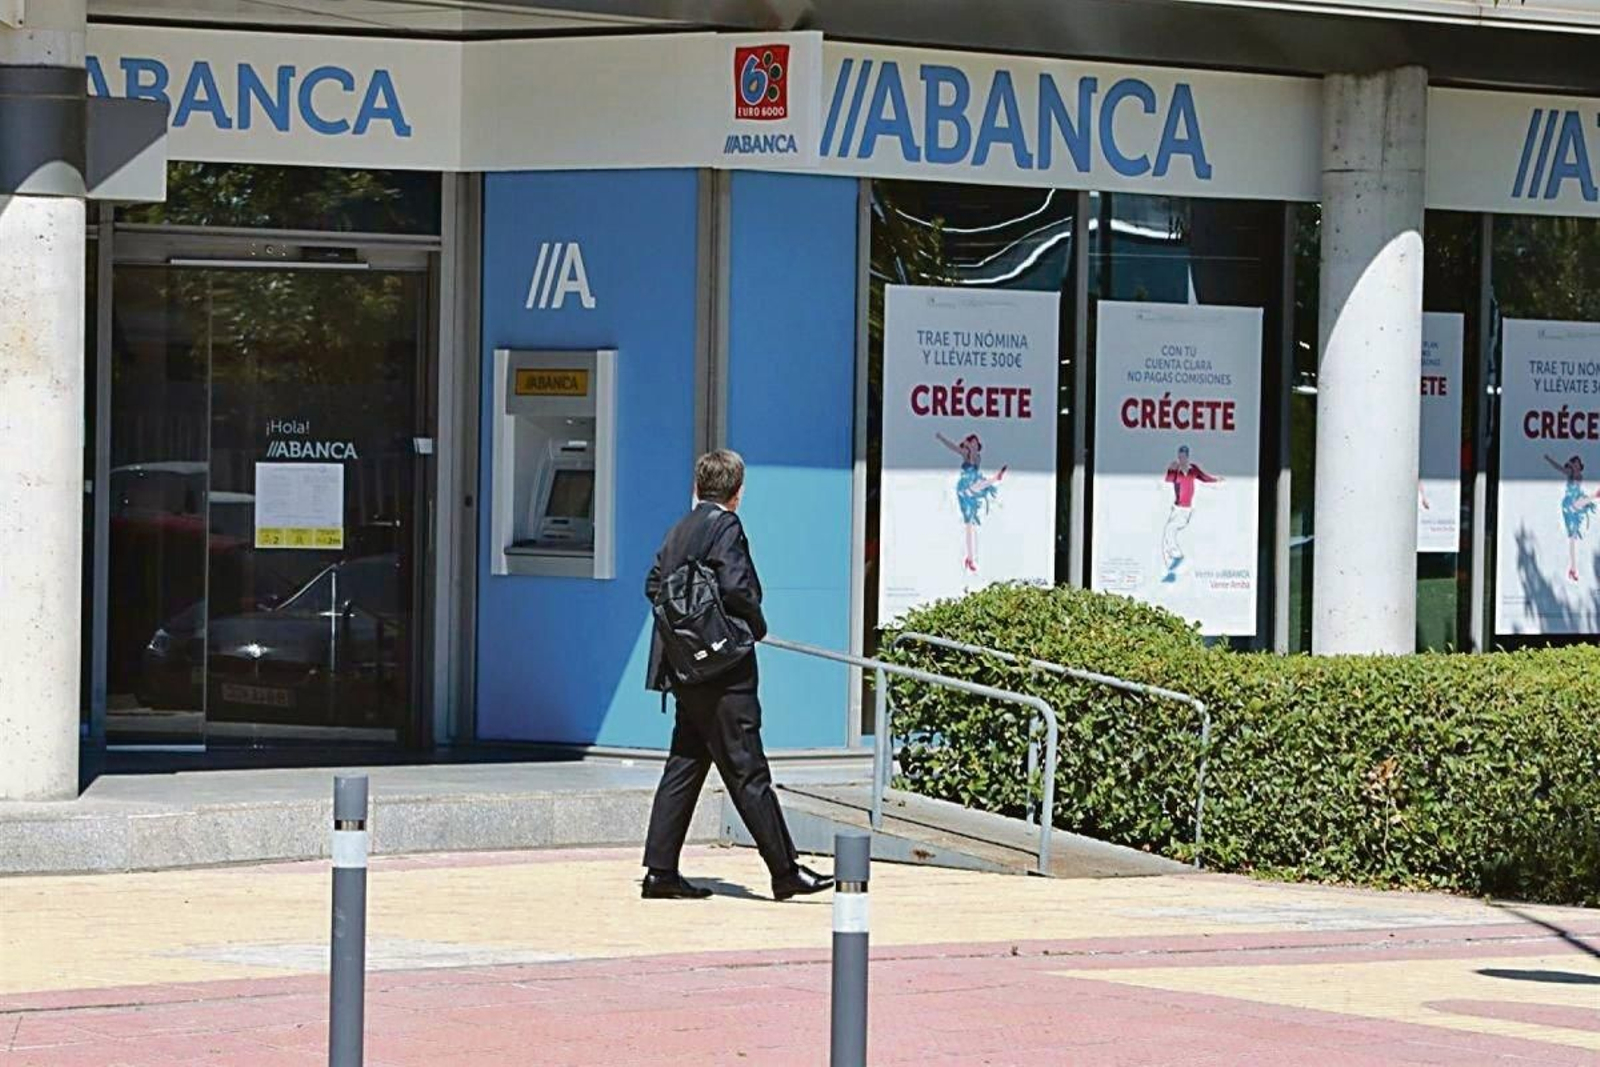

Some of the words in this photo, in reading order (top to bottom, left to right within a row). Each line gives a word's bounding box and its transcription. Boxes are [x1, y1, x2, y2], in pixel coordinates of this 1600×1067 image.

[738, 107, 760, 116] EURO
[762, 107, 785, 116] 6000
[917, 330, 949, 346] TRAE
[953, 332, 971, 347] TU
[974, 330, 1028, 348] NÓMINA
[923, 350, 931, 365] Y
[934, 347, 987, 366] LLÉVATE
[991, 351, 1022, 368] 300€
[1161, 345, 1182, 357] CON
[1184, 346, 1197, 357] TU
[1145, 358, 1180, 370] CUENTA
[1183, 359, 1212, 371] CLARA
[1530, 361, 1557, 375] TRAE
[1561, 362, 1576, 375] TU
[1127, 371, 1142, 382] NO
[1144, 371, 1173, 383] PAGAS
[1175, 373, 1232, 385] COMISIONES
[1534, 379, 1541, 391] Y
[1544, 376, 1588, 394] LLÉVATE
[911, 378, 1031, 418] CRÉCETE
[1121, 392, 1236, 431] CRÉCETE
[266, 420, 310, 436] ¡Hola!
